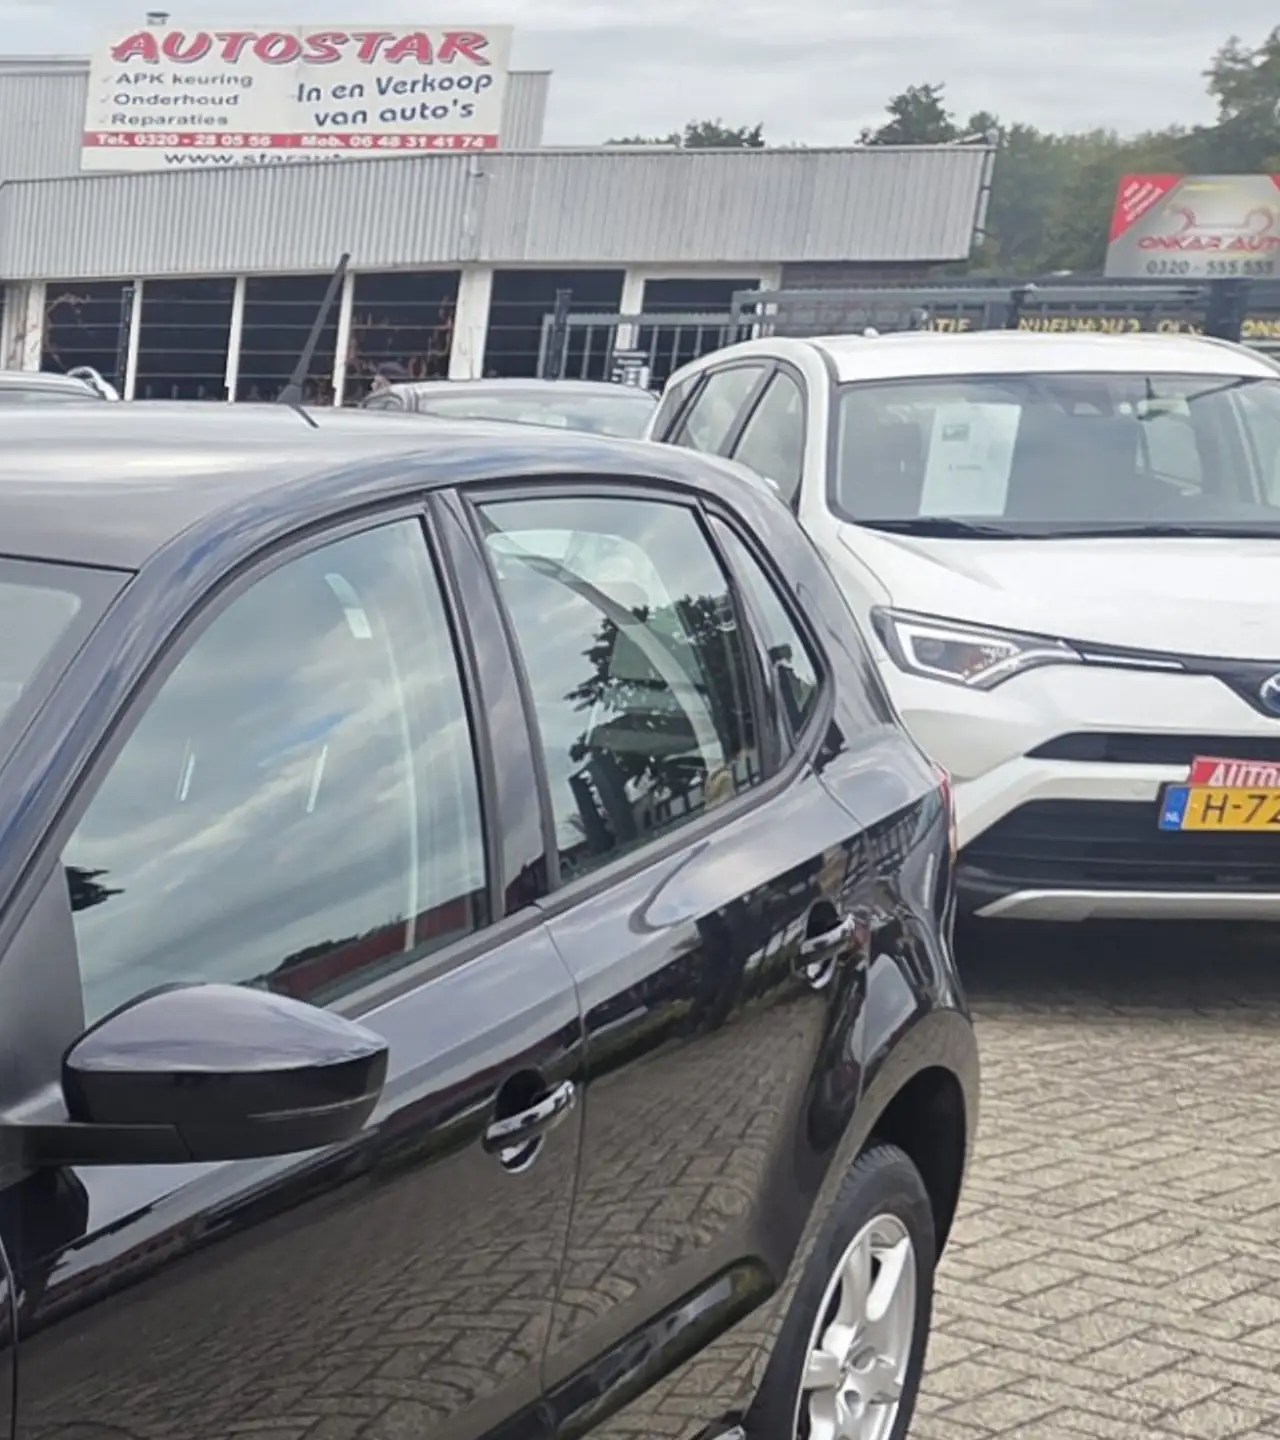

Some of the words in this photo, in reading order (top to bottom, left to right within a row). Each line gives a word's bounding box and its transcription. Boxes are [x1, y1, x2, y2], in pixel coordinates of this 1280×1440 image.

[111, 31, 492, 66] AUTOSTAR
[116, 73, 164, 85] APK
[172, 73, 254, 88] keuring
[297, 83, 321, 103] In
[332, 84, 364, 99] en
[375, 73, 493, 97] Verkoop
[114, 93, 240, 106] Onderhoud
[111, 113, 229, 127] Reparaties
[314, 109, 368, 128] van
[379, 99, 475, 123] auto's
[97, 134, 130, 146] Tel.
[134, 134, 179, 146] 0320
[300, 136, 346, 147] Mob.
[349, 135, 373, 147] 06
[405, 135, 427, 147] 31
[461, 136, 485, 147] 74
